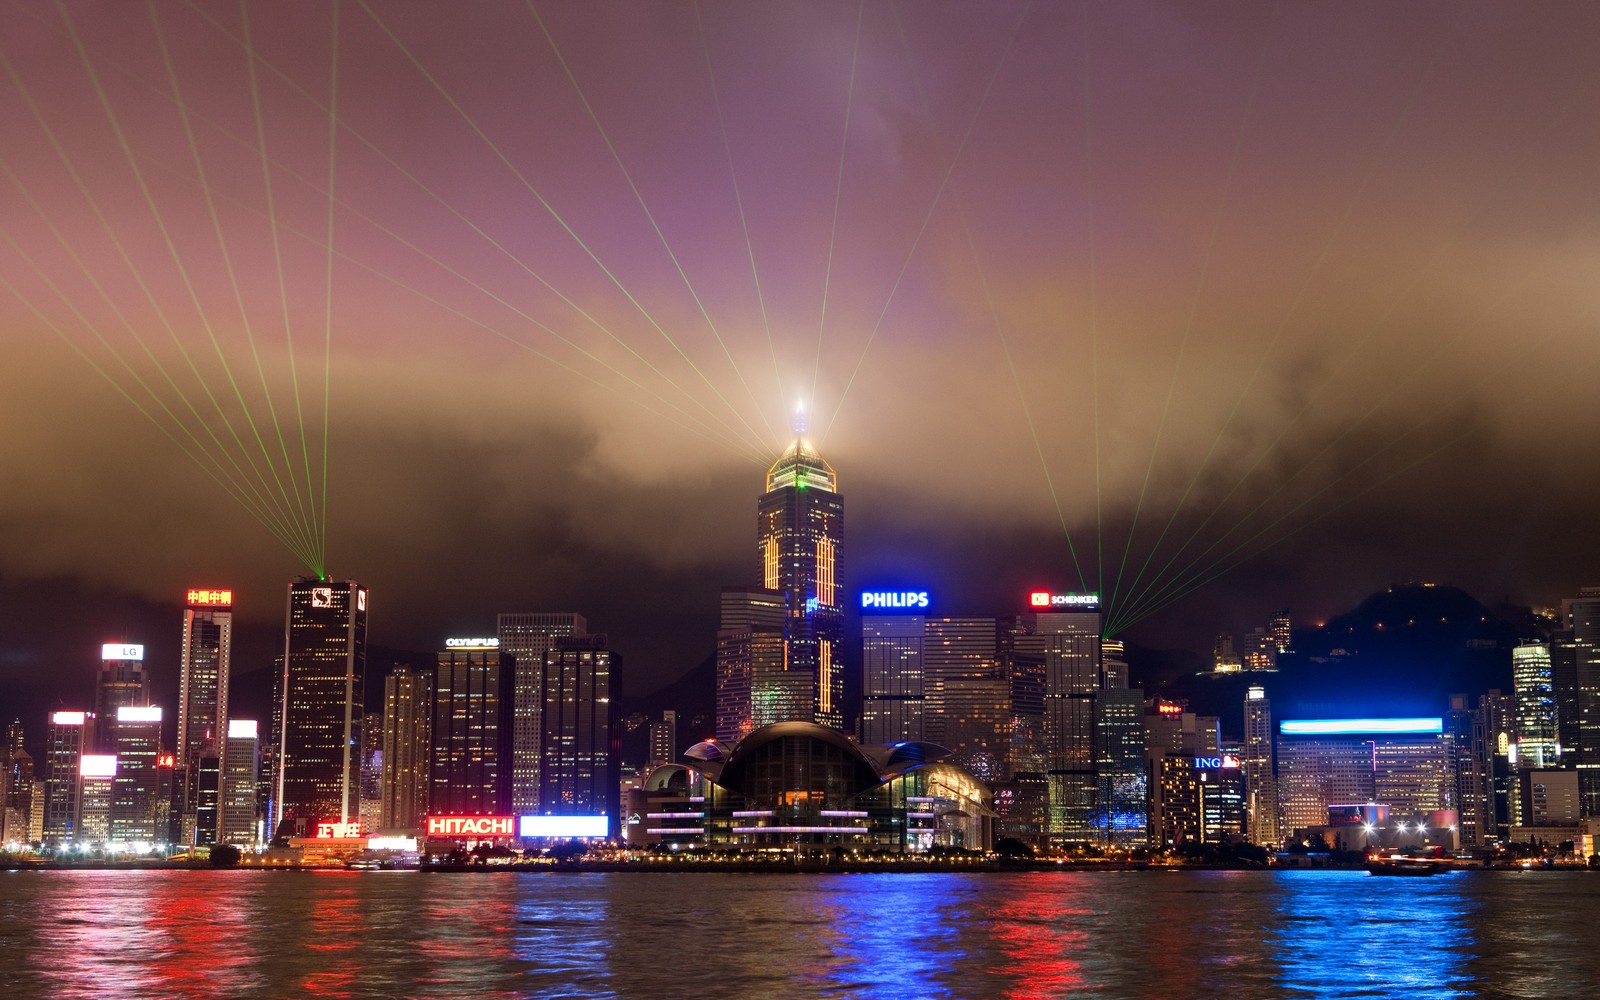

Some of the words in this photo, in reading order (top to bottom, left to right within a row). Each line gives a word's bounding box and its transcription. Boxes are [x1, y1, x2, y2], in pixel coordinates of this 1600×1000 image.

[862, 592, 929, 607] PHILIPS
[1051, 595, 1099, 604] SCHENKER
[445, 638, 500, 647] OLYMPUS
[122, 647, 137, 657] LG
[1195, 757, 1221, 768] ING
[429, 818, 513, 834] HITACHI
